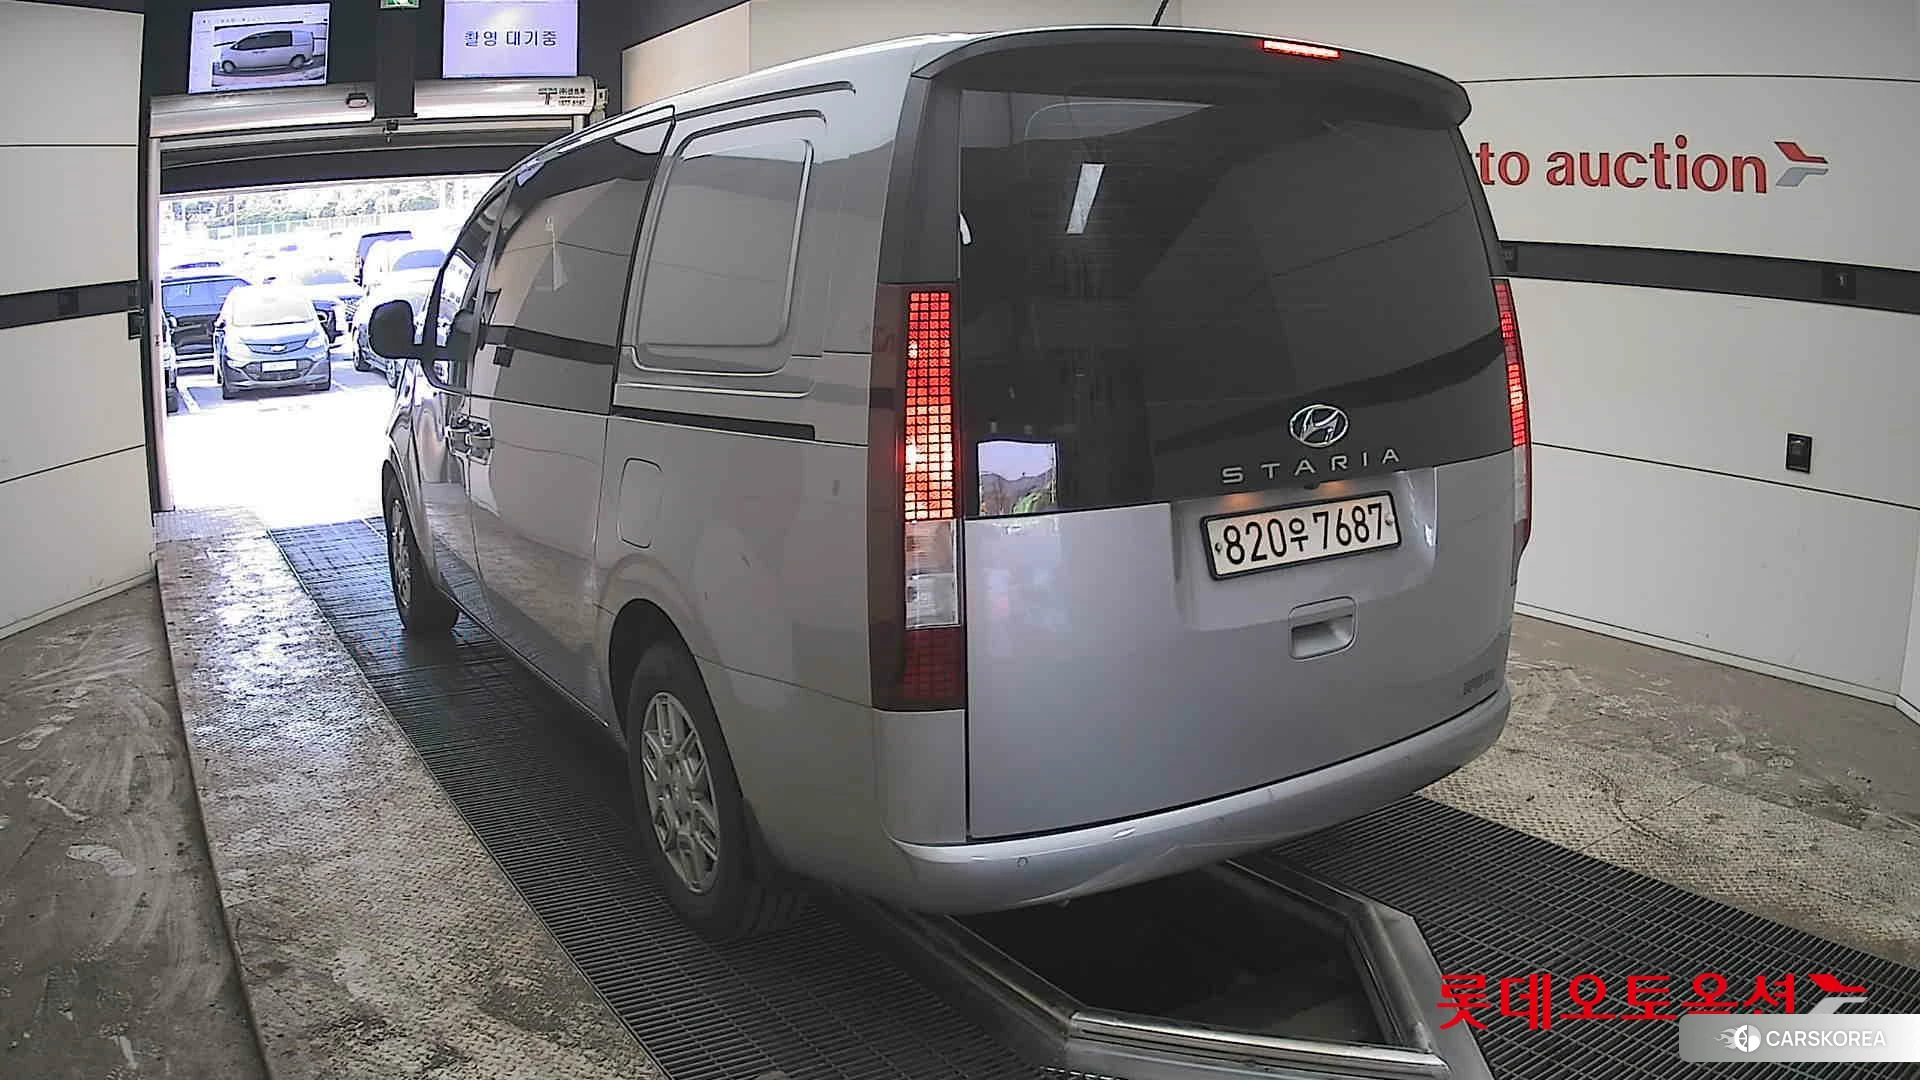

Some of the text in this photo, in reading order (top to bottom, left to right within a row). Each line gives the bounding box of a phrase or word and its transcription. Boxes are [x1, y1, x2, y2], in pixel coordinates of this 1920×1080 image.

[505, 30, 558, 47] 대기중
[1546, 134, 1768, 194] auction
[1221, 447, 1401, 485] STARIA
[1222, 502, 1384, 566] 820우7687
